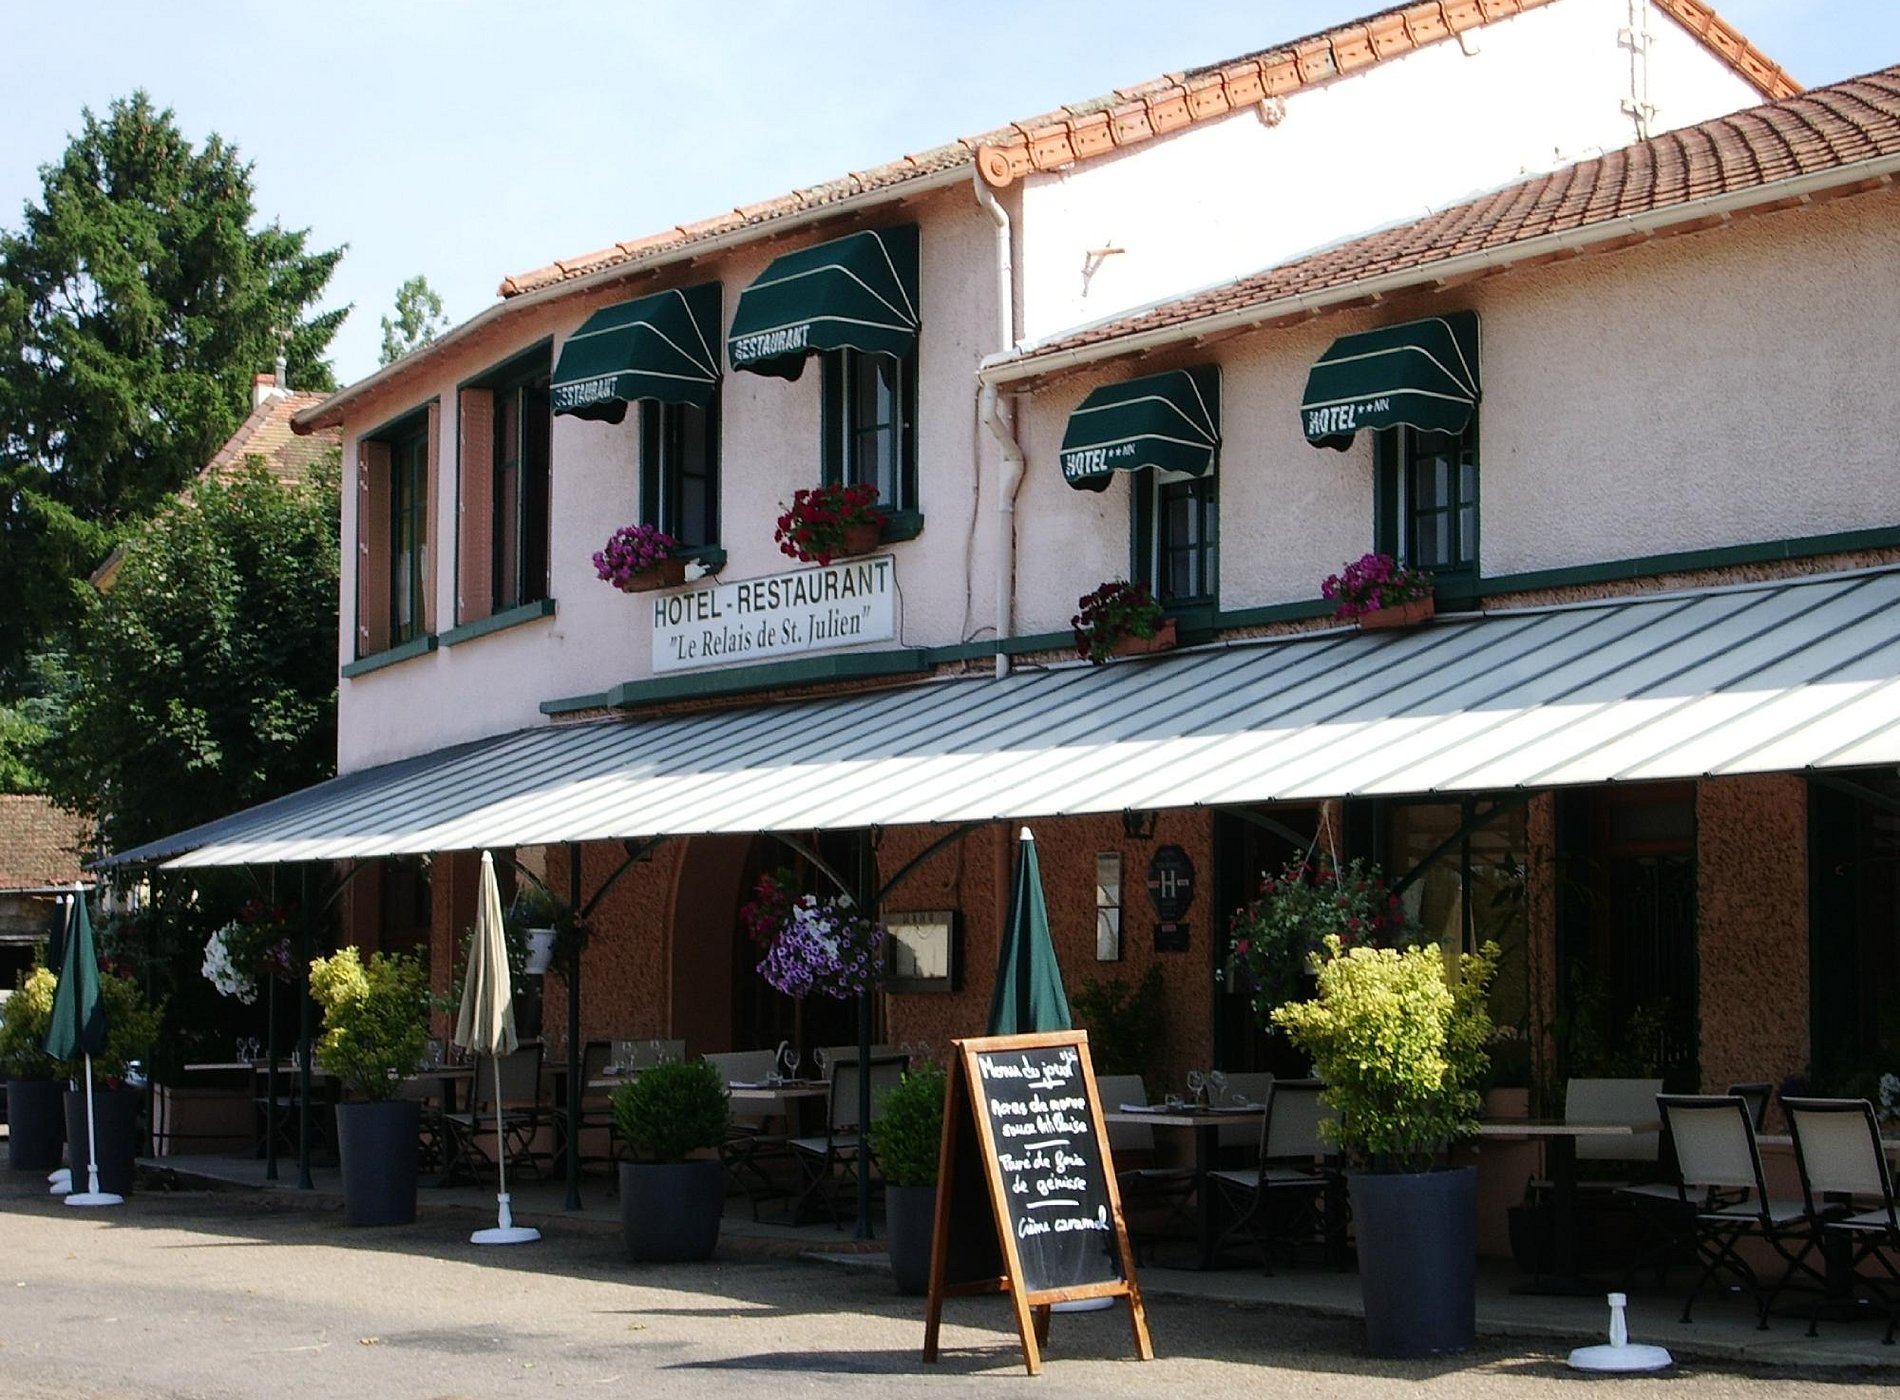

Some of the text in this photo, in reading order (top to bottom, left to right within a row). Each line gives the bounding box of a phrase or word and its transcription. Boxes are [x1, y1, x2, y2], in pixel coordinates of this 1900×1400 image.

[735, 324, 810, 360] RESTAURANT
[1308, 404, 1356, 435] HOTEL
[1065, 448, 1108, 477] HOTEL
[654, 590, 722, 629] HOTEL
[738, 561, 889, 615] RESTAURANT
[701, 624, 751, 657] Relais
[757, 620, 775, 649] de
[780, 617, 802, 645] St.
[1160, 870, 1176, 899] H
[978, 1055, 1023, 1079] Menu
[1021, 1054, 1041, 1079] du
[1029, 1093, 1049, 1113] de
[998, 1151, 1031, 1172] Pavé
[1033, 1149, 1052, 1169] de
[1012, 1172, 1087, 1196] de génisse
[1055, 1205, 1110, 1232] caramel
